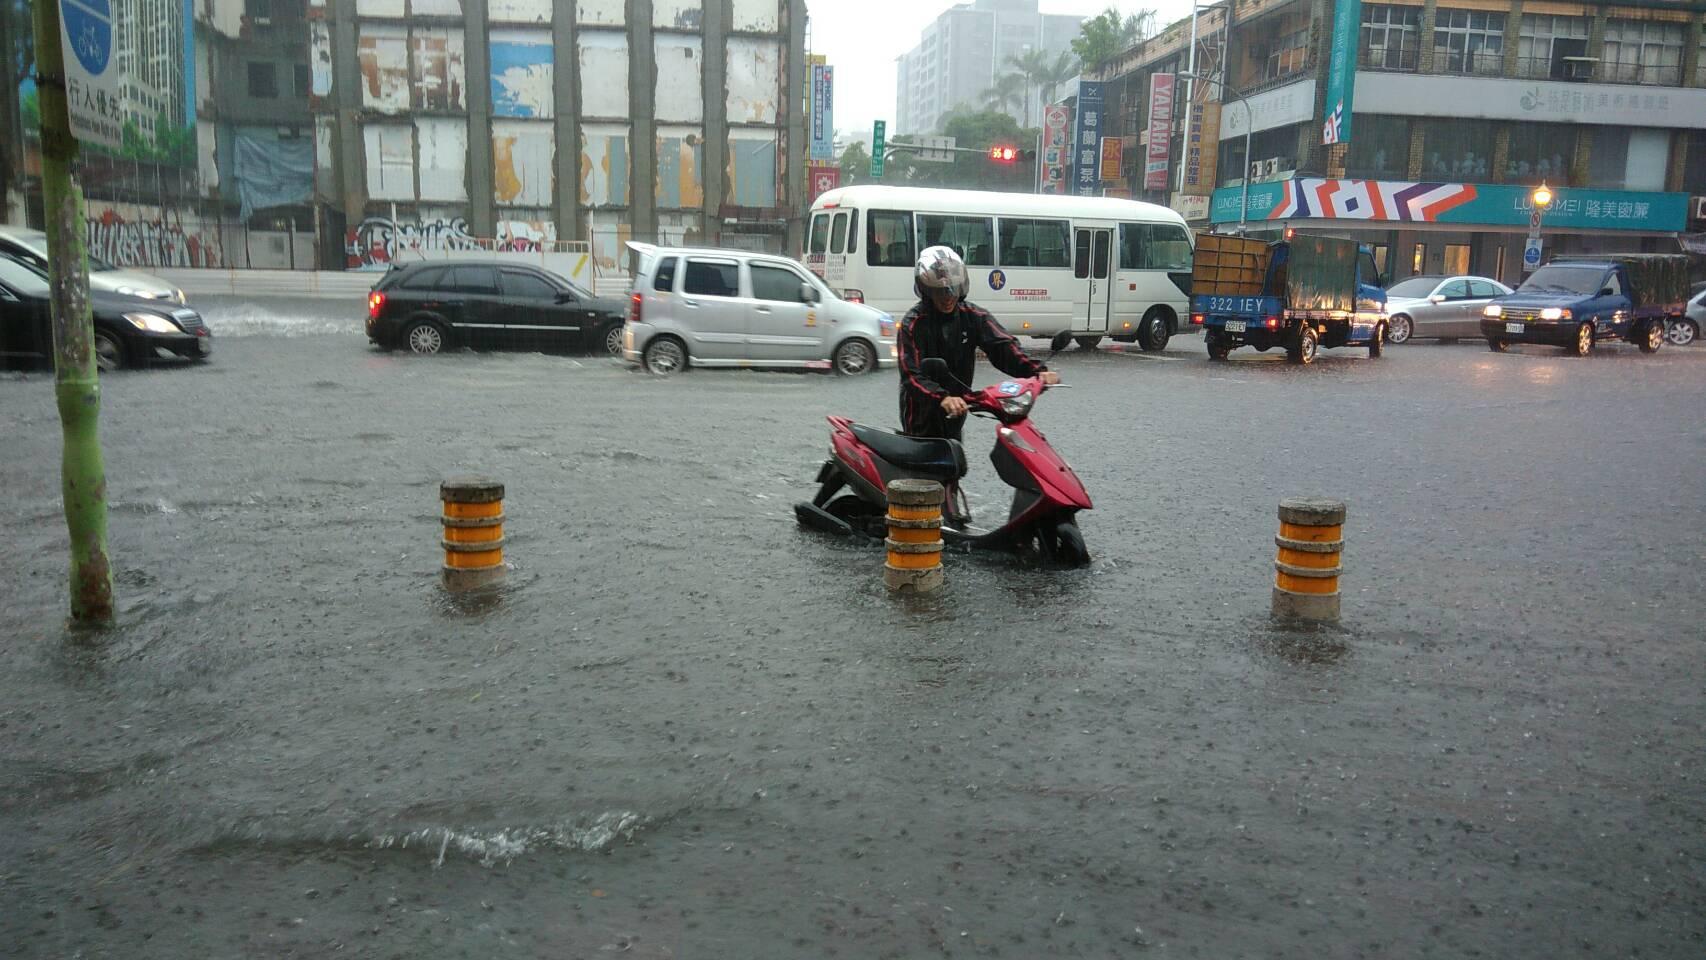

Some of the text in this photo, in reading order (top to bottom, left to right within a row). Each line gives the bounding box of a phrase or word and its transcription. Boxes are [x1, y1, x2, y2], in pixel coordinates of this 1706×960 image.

[68, 77, 120, 120] 行人優先
[1151, 84, 1171, 155] YAMAHA
[1210, 297, 1233, 311] 322
